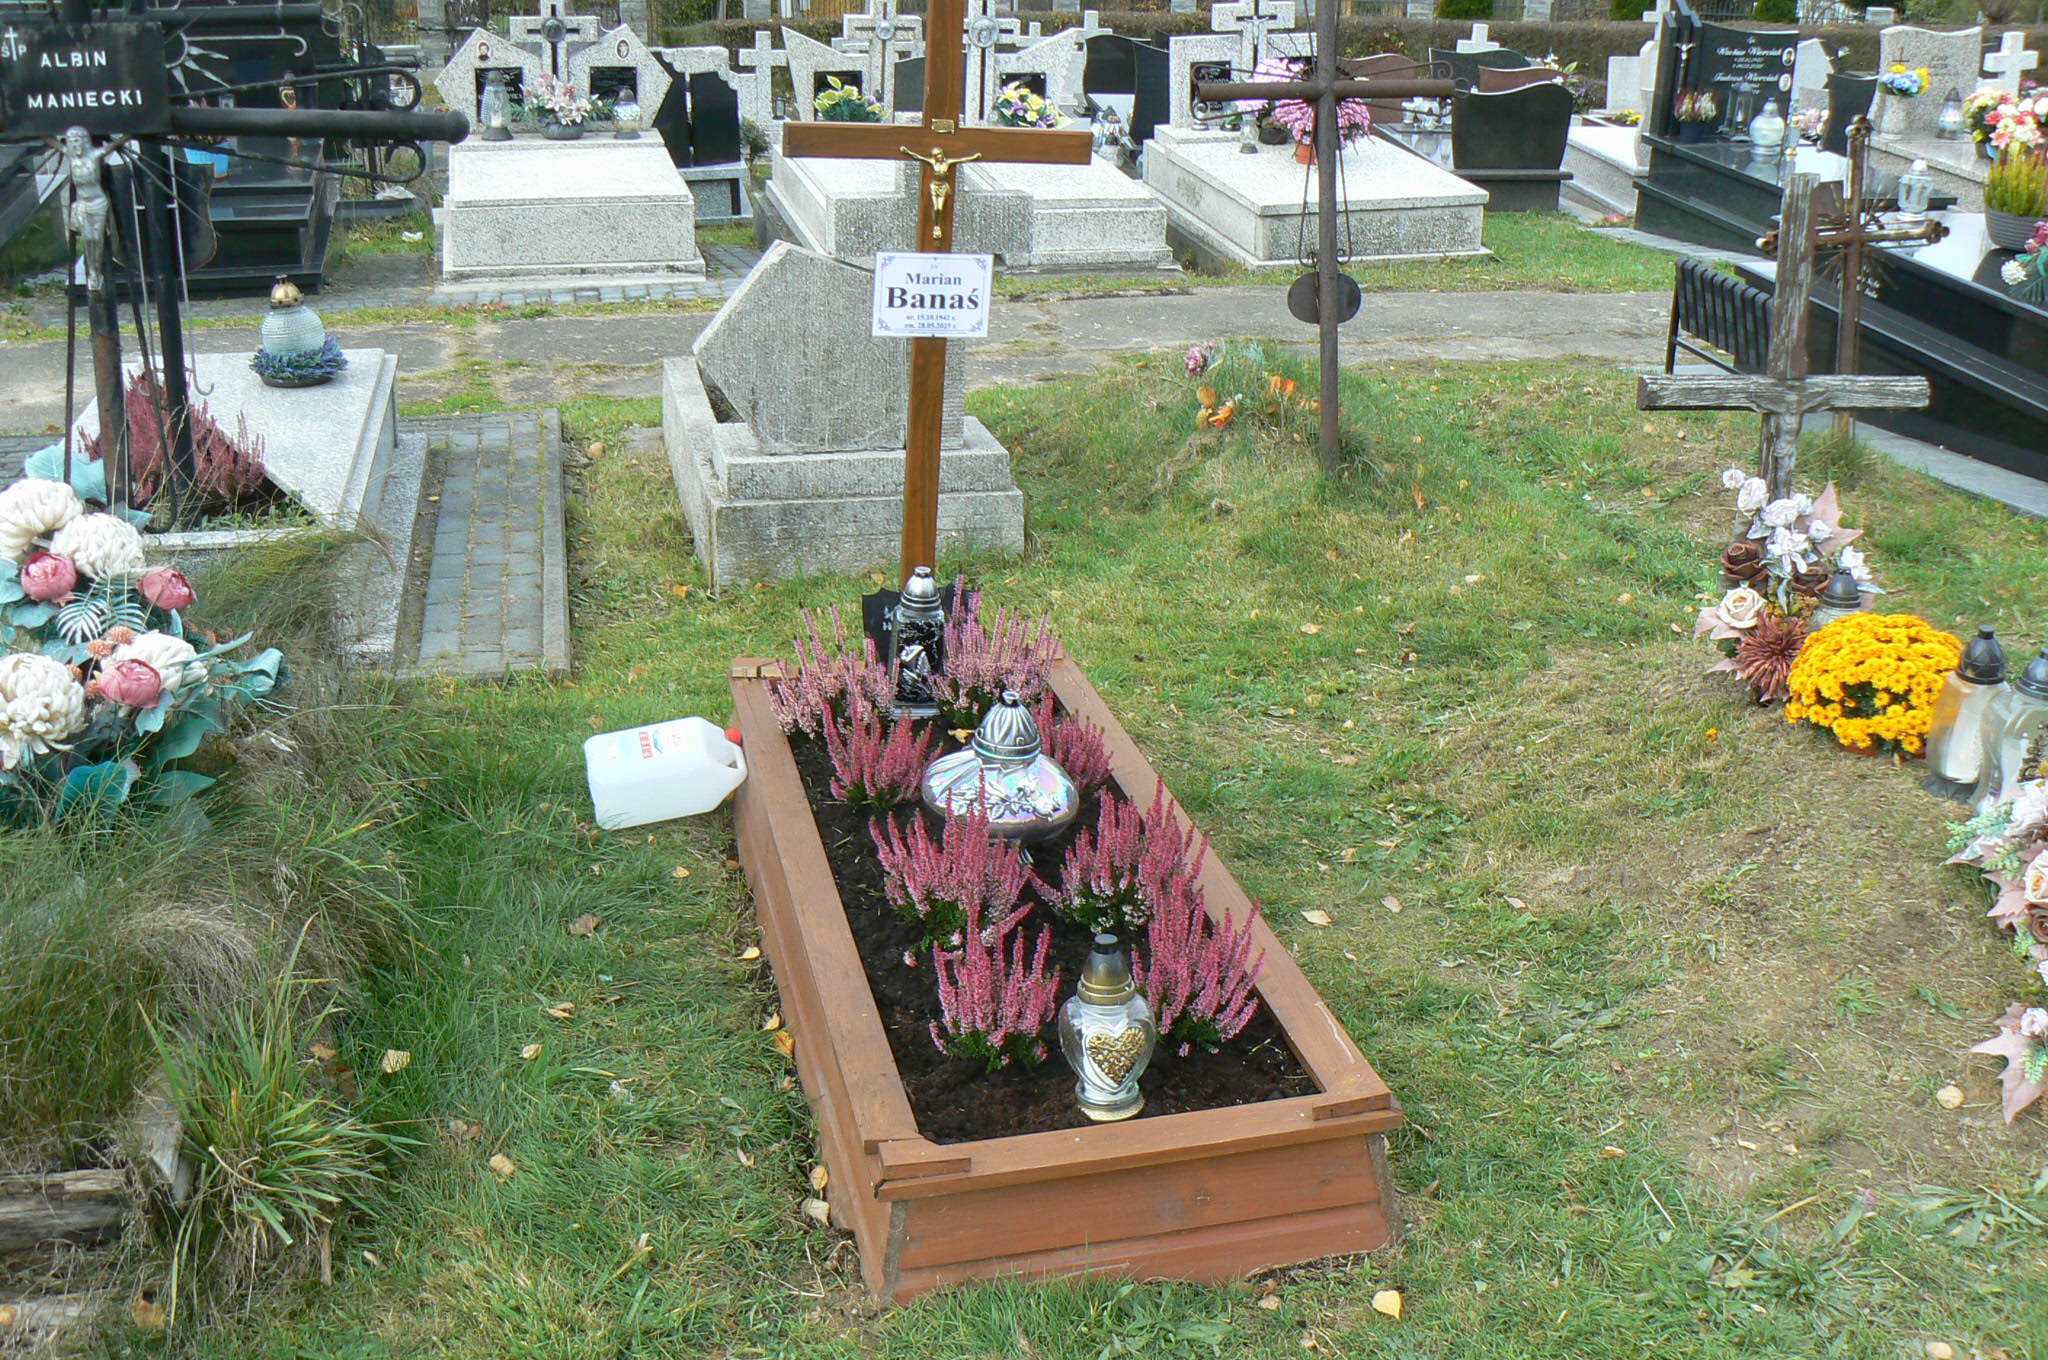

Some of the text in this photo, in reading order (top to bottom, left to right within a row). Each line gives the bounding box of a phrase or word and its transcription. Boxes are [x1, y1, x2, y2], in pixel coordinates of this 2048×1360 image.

[41, 50, 107, 68] ALBIN
[27, 89, 143, 109] MANIECKI
[905, 273, 962, 286] Marian
[885, 287, 980, 310] Banaś
